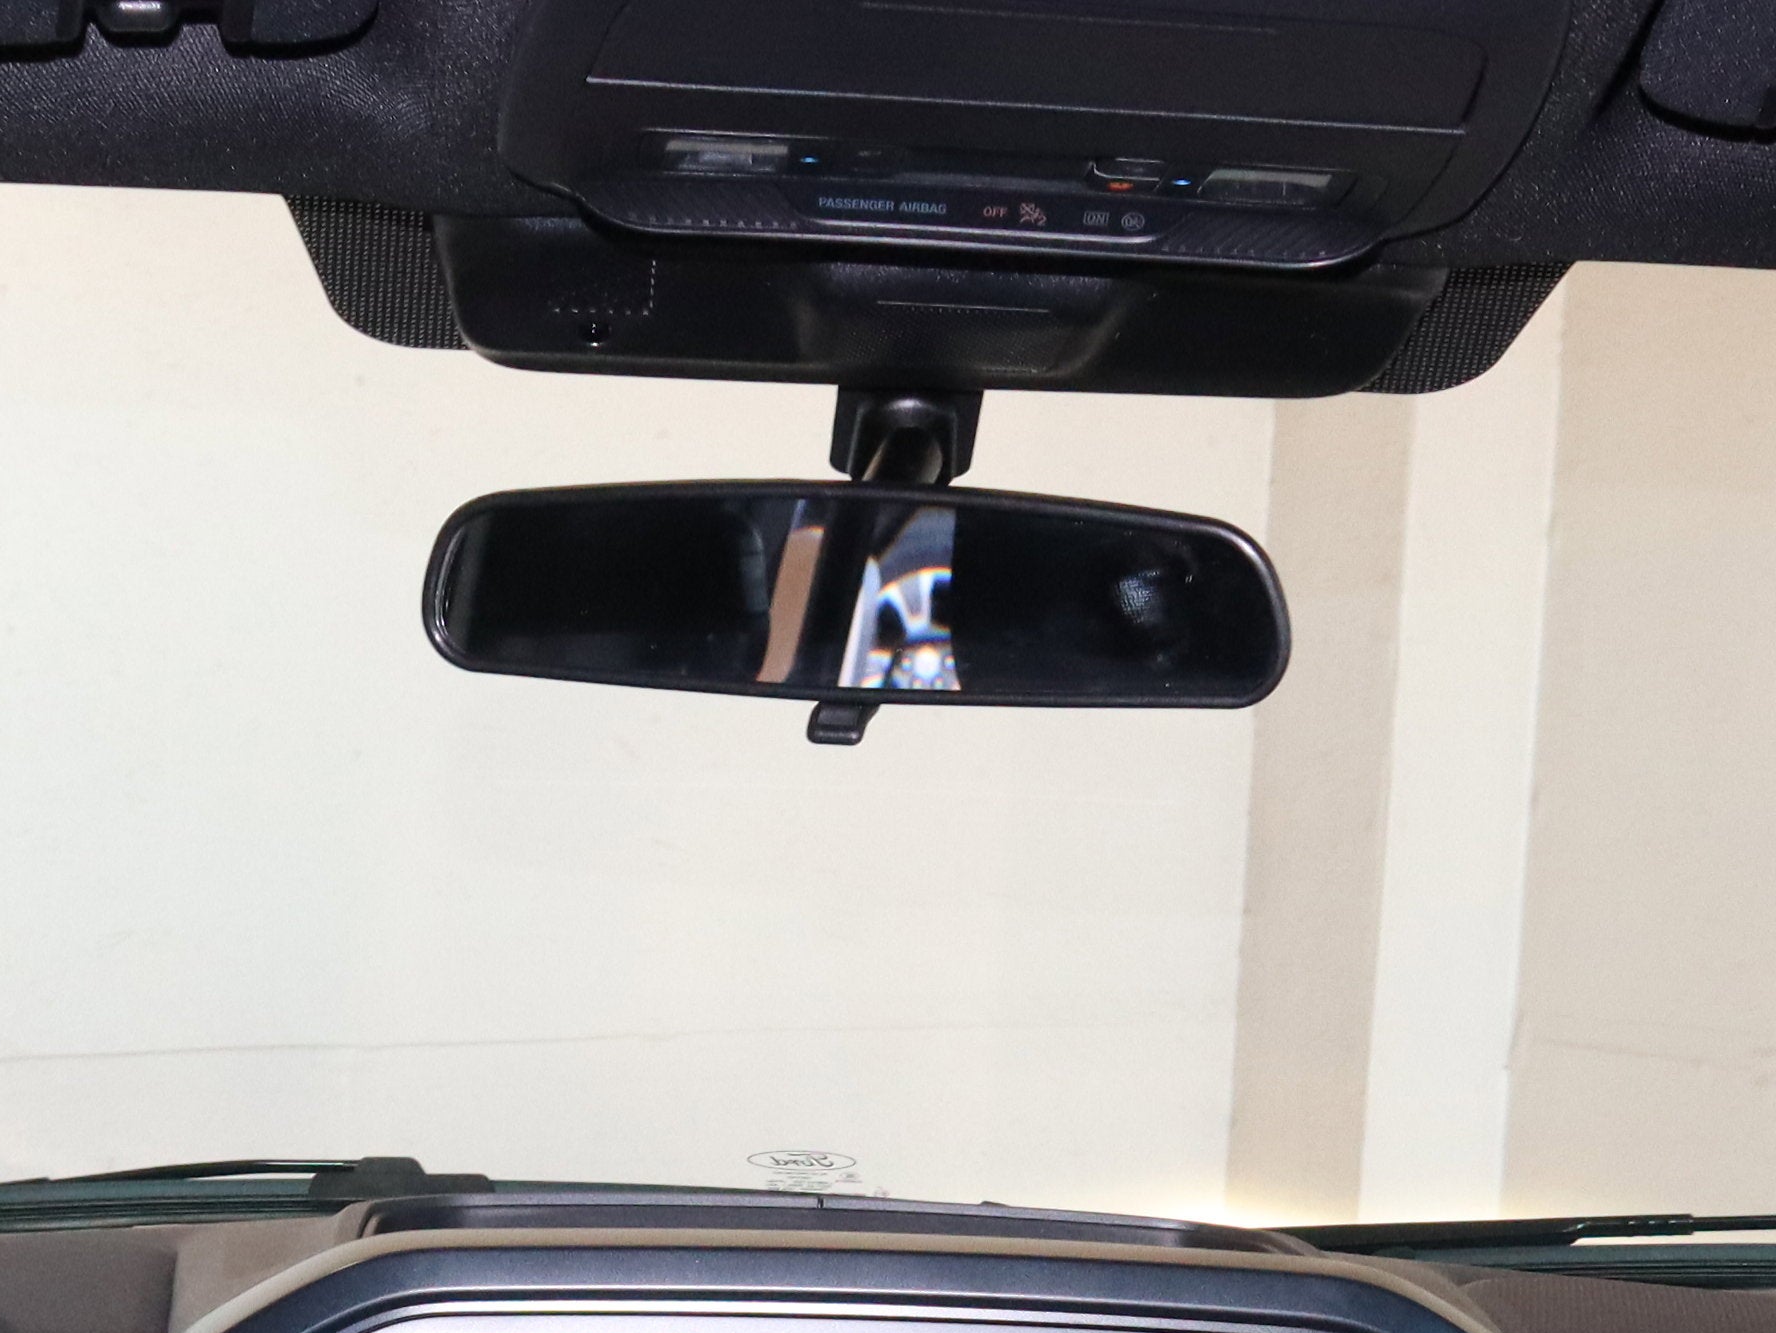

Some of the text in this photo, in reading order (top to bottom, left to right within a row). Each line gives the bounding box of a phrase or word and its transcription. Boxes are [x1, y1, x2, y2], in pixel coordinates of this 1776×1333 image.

[818, 197, 895, 212] PASSENGER
[899, 202, 947, 215] AIRBAG
[983, 206, 1008, 218] OFF
